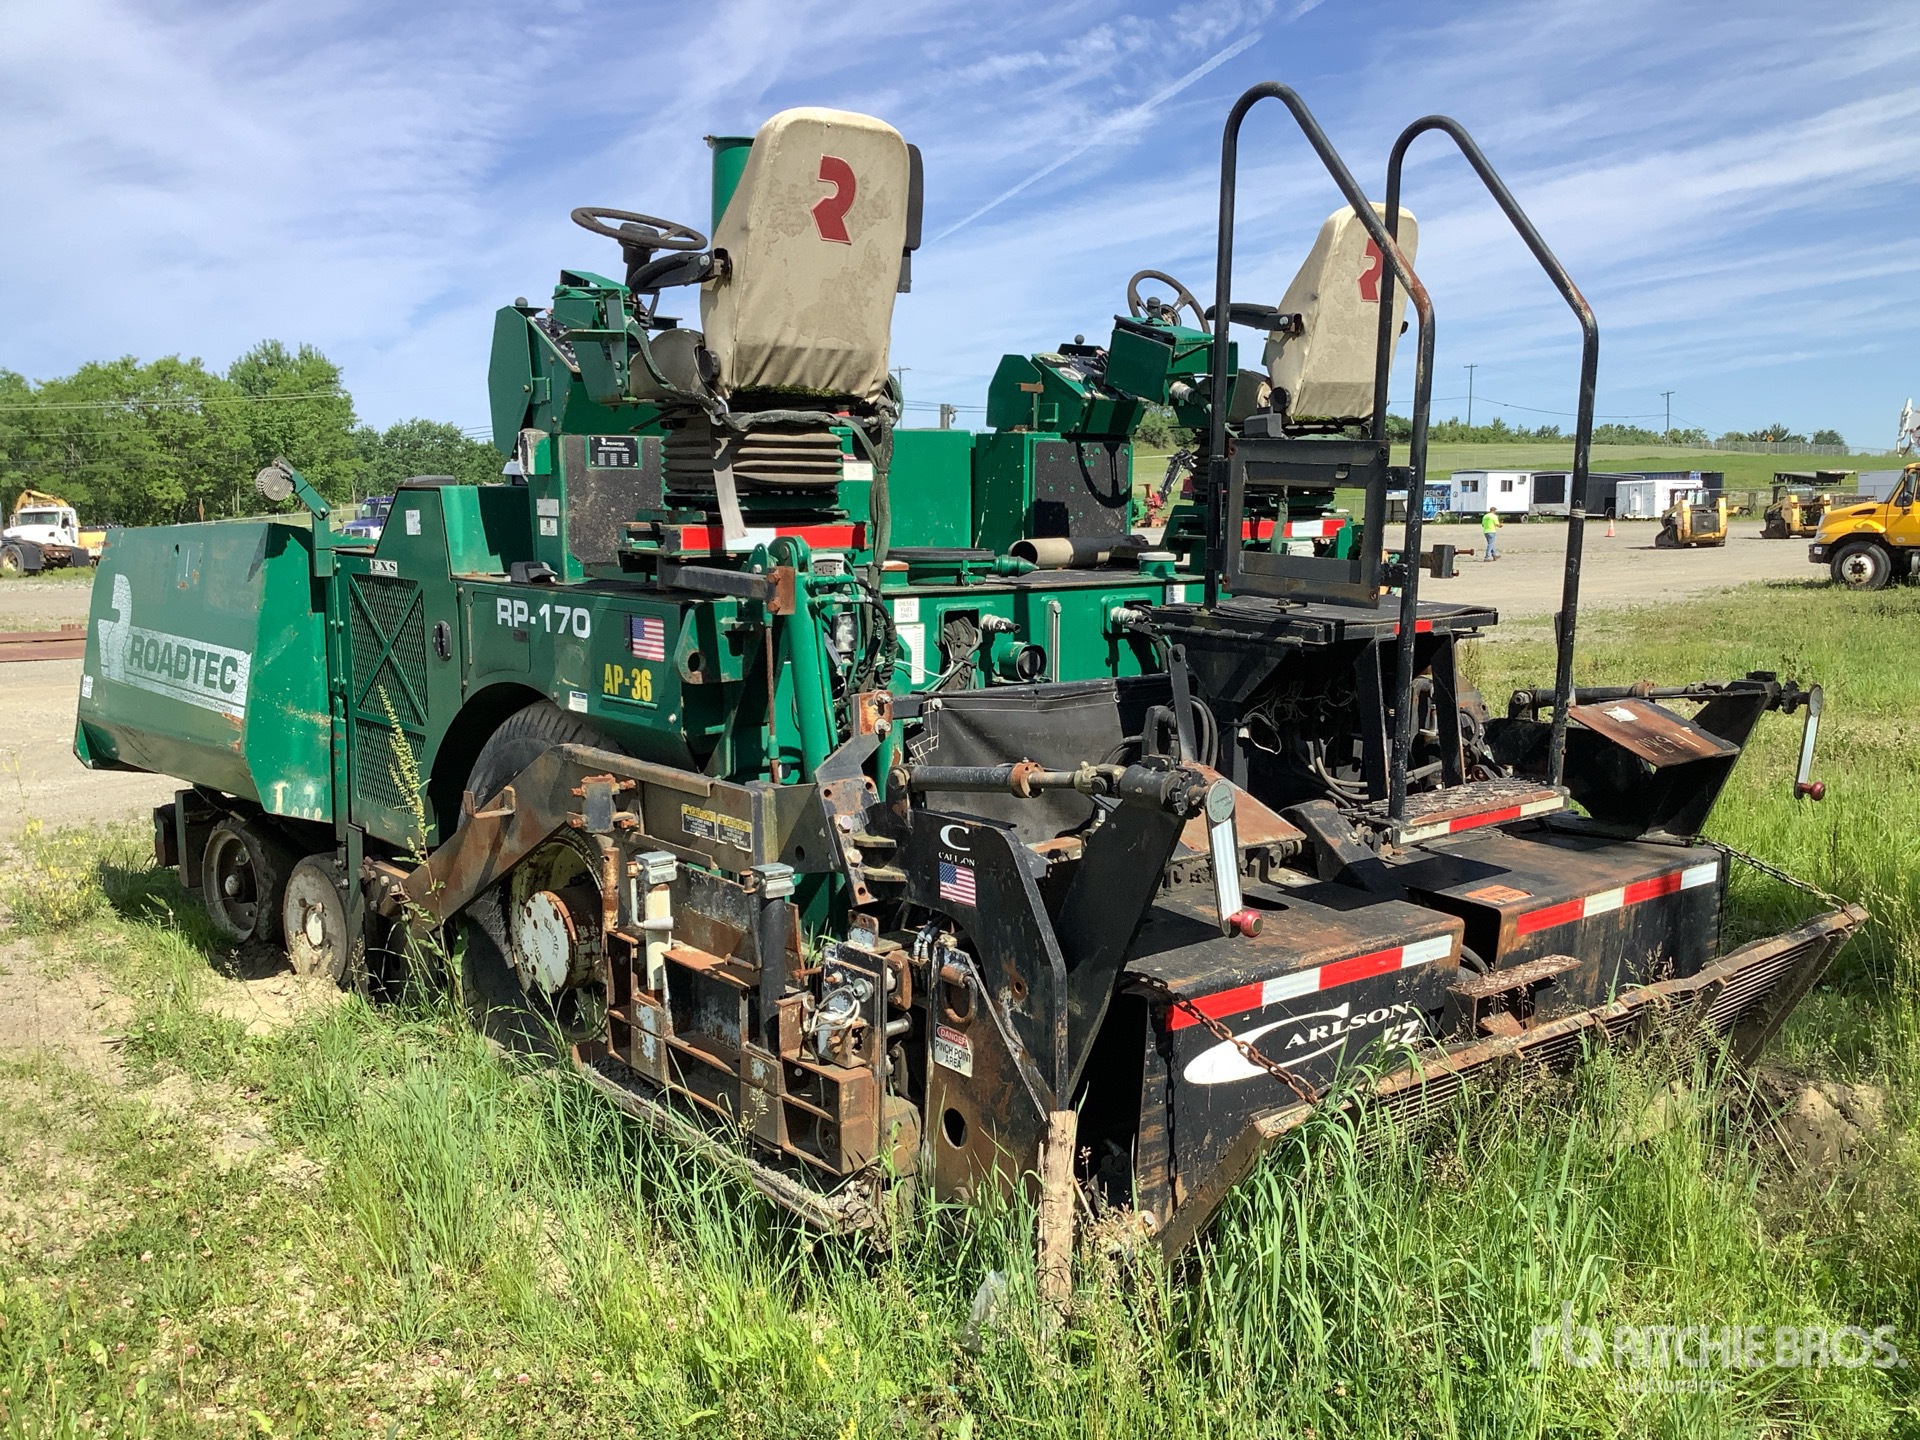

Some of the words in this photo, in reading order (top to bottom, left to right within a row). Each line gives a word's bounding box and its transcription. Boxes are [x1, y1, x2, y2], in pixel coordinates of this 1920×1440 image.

[496, 597, 591, 639] RP-170
[129, 634, 238, 695] ROADTEC
[603, 663, 652, 702] AP-36
[936, 1040, 953, 1056] PINCH
[954, 1048, 971, 1064] POINT
[945, 1055, 962, 1070] AREA
